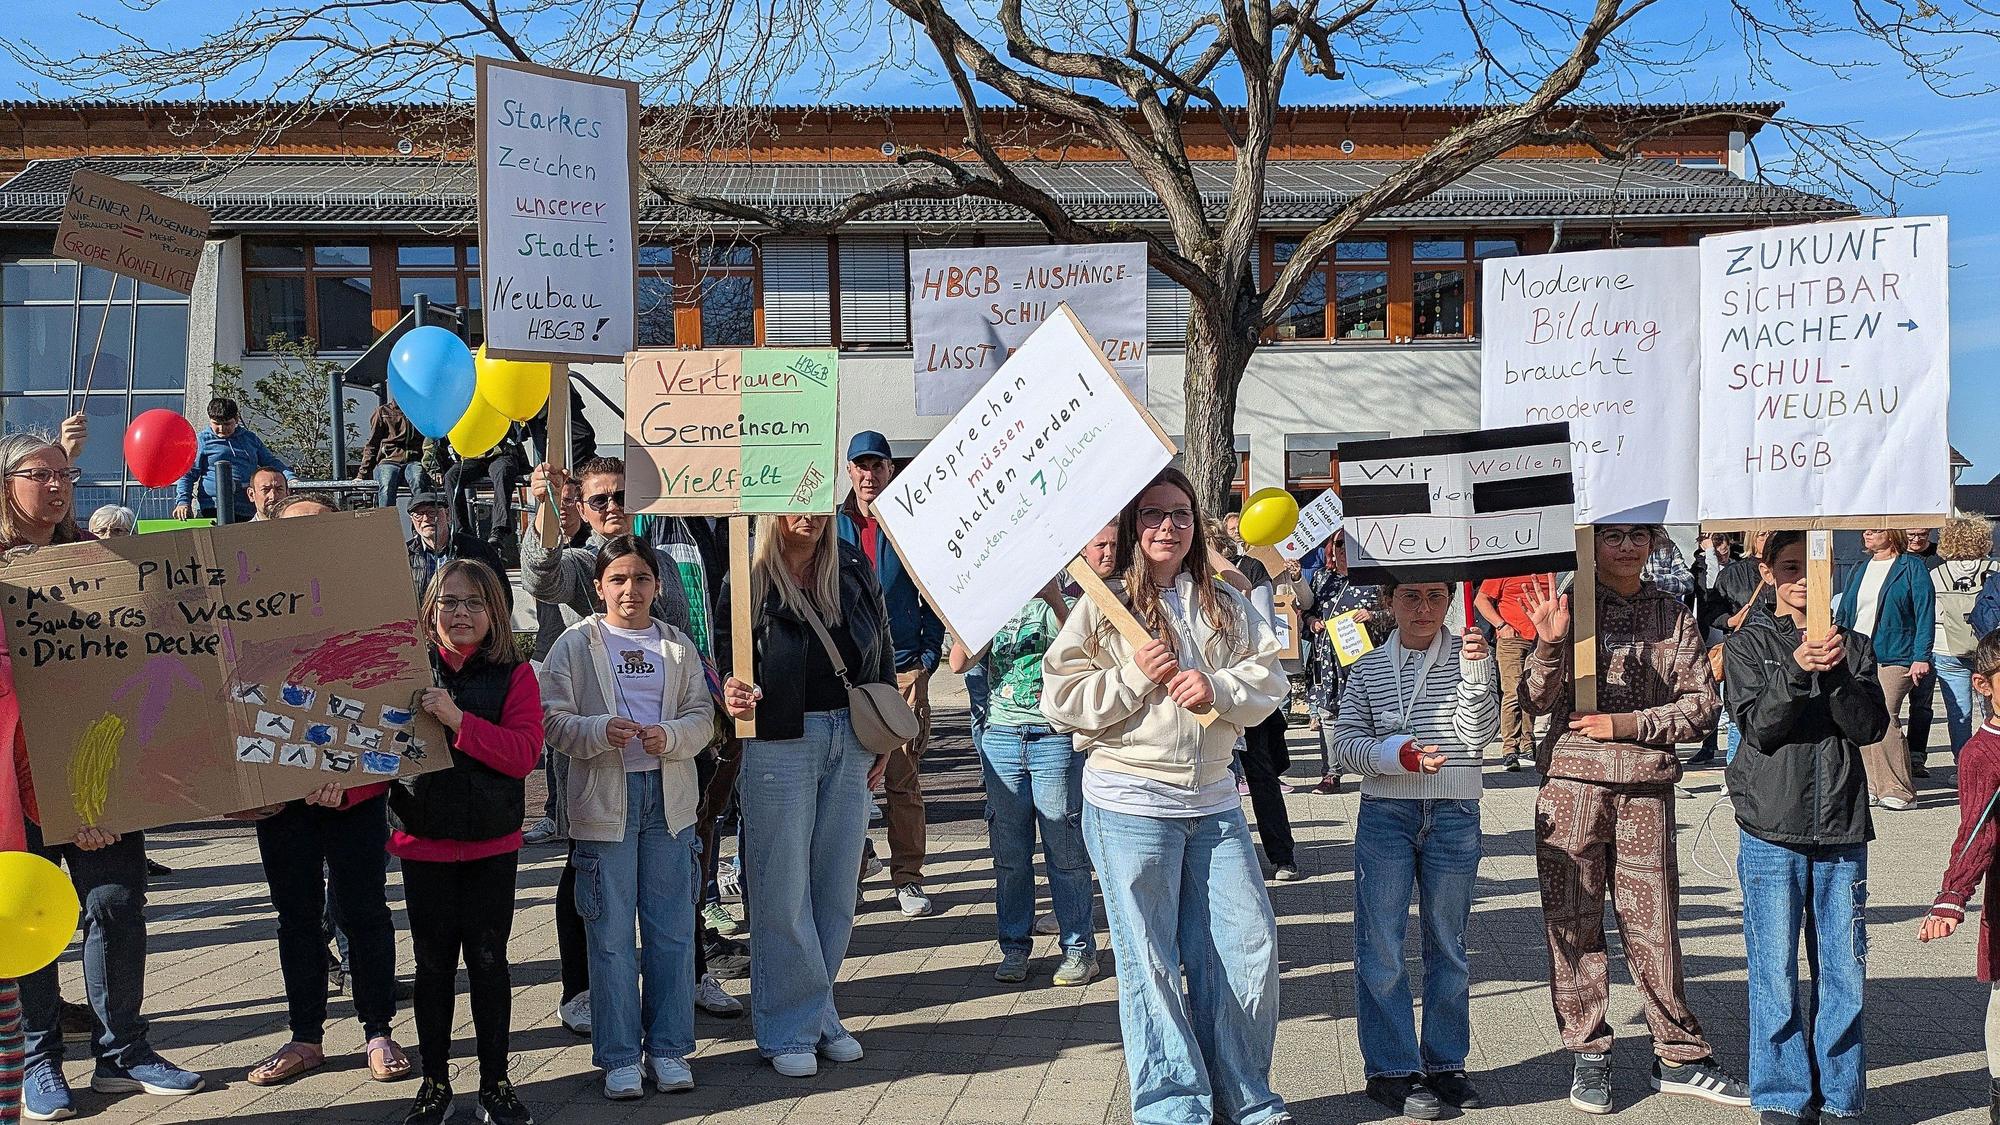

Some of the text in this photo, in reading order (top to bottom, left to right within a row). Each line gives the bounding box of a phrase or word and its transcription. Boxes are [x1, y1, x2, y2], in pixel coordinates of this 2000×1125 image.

[498, 99, 602, 139] Starkes
[499, 146, 596, 181] Zeichen
[68, 210, 90, 222] WIR
[69, 184, 131, 223] KLEINER
[516, 196, 607, 218] unserer
[149, 233, 176, 243] MEHR
[518, 233, 614, 258] Stadt:
[1725, 223, 1931, 276] ZUKUNFT
[116, 244, 196, 291] KONFLIKTE
[921, 266, 1001, 301] HBGB
[1501, 264, 1635, 302] Moderne
[493, 276, 602, 311] Neubau
[1525, 301, 1662, 352] Bildung
[1721, 311, 1882, 353] MACHEN
[794, 355, 829, 381] HBGB
[927, 344, 996, 372] LASST
[1504, 348, 1633, 385] braucht
[1728, 357, 1850, 390] SCHUL-
[657, 359, 797, 394] Vertrauen
[1525, 395, 1636, 423] moderne
[1757, 385, 1899, 421] NEUBAU
[641, 402, 809, 445] Gemeinsam
[895, 375, 1026, 517] Versprechen
[967, 418, 1025, 489] müssen
[1745, 441, 1832, 474] HBGB
[662, 465, 782, 495] Vielfalt
[1359, 454, 1563, 481] Wir Wollen
[797, 467, 825, 505] HBGB
[1432, 486, 1473, 502] den
[947, 467, 1017, 559] gehalten
[1304, 511, 1320, 528] sind
[1315, 502, 1336, 527] Kinder
[949, 571, 973, 595] Wir
[974, 530, 1008, 570] warten
[1010, 492, 1033, 526] seit
[1029, 469, 1048, 496] 7
[27, 576, 106, 609] Mehr
[27, 606, 147, 636] Sauberes
[33, 634, 129, 667] Dichte
[617, 662, 656, 675] 1982
